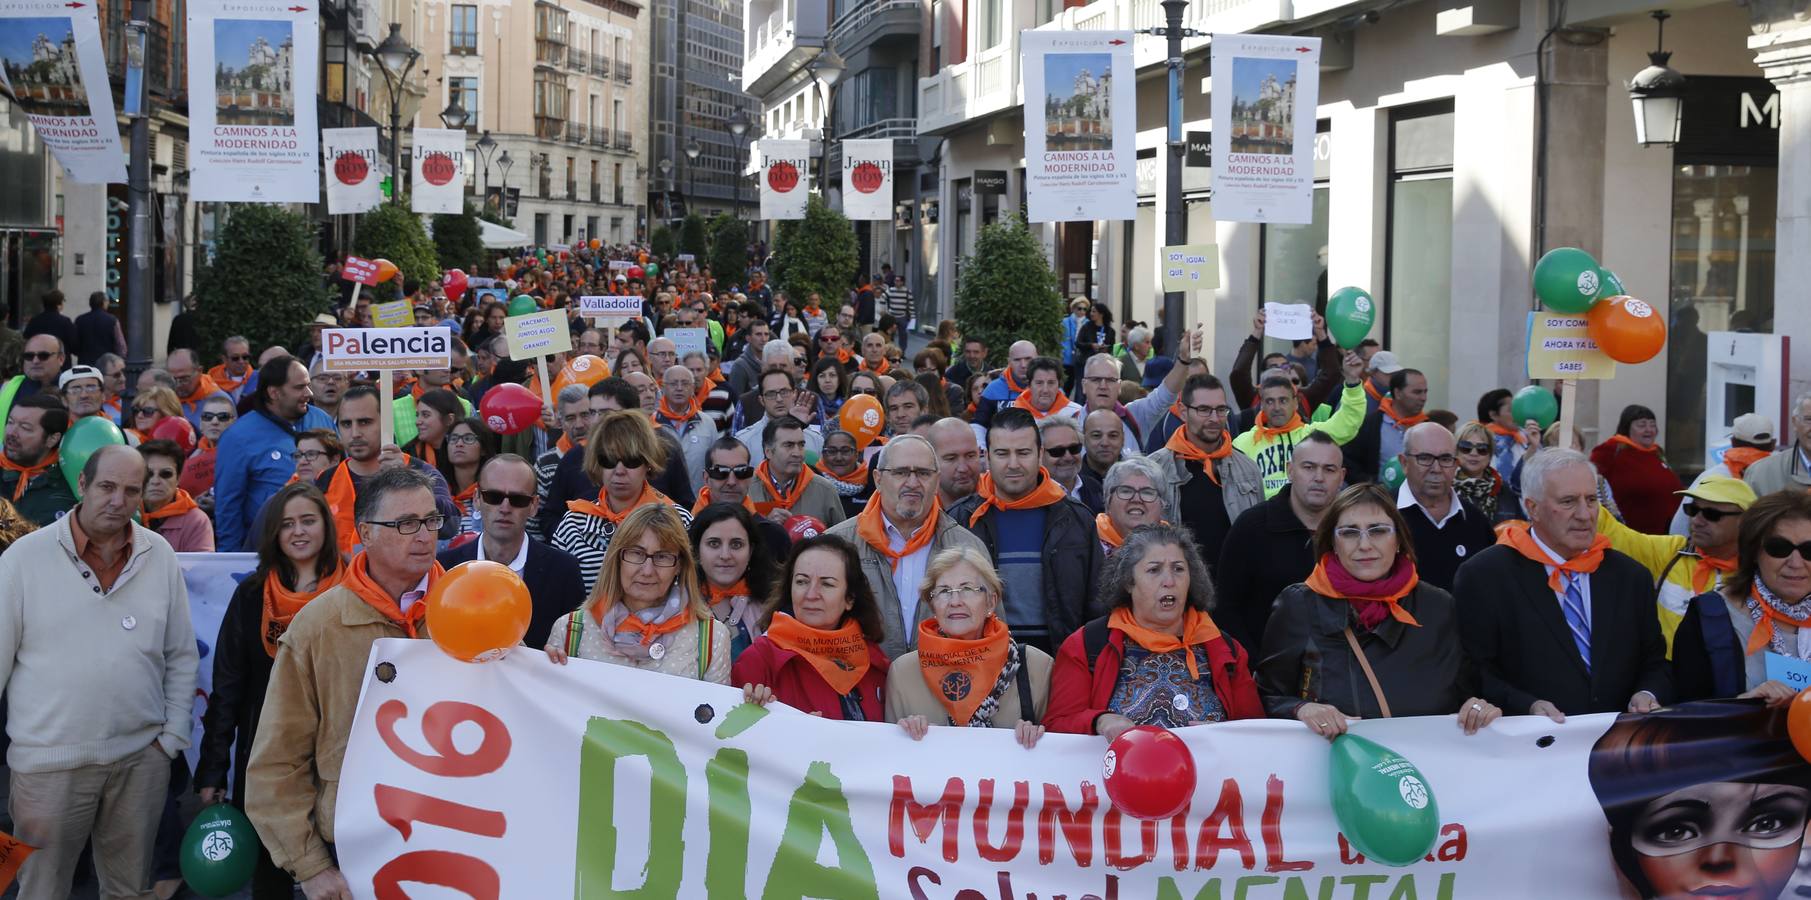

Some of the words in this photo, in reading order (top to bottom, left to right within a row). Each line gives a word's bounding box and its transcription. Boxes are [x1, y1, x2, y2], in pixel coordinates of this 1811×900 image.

[31, 116, 66, 126] MINOS
[70, 118, 79, 126] A
[81, 118, 96, 127] LA
[38, 128, 98, 137] DERNIDAD
[214, 127, 267, 137] CAMINOS
[271, 128, 279, 137] A
[283, 128, 297, 137] LA
[214, 139, 297, 149] MODERNIDAD
[326, 145, 376, 163] Japan
[415, 145, 463, 163] Japan
[1044, 153, 1089, 161] CAMINOS
[1102, 152, 1115, 160] LA
[1228, 154, 1271, 163] CAMINOS
[1274, 156, 1280, 164] A
[761, 155, 807, 171] Japan
[844, 156, 892, 171] Japan
[1044, 163, 1115, 173] MODERNIDAD
[1228, 166, 1294, 175] MODERNIDAD
[583, 299, 640, 309] Valladolid
[328, 331, 446, 355] Palencia
[814, 636, 851, 645] MUNDIAL
[1786, 671, 1808, 682] SOY
[574, 702, 878, 900] DÍA
[887, 772, 1316, 872] MUNDIAL
